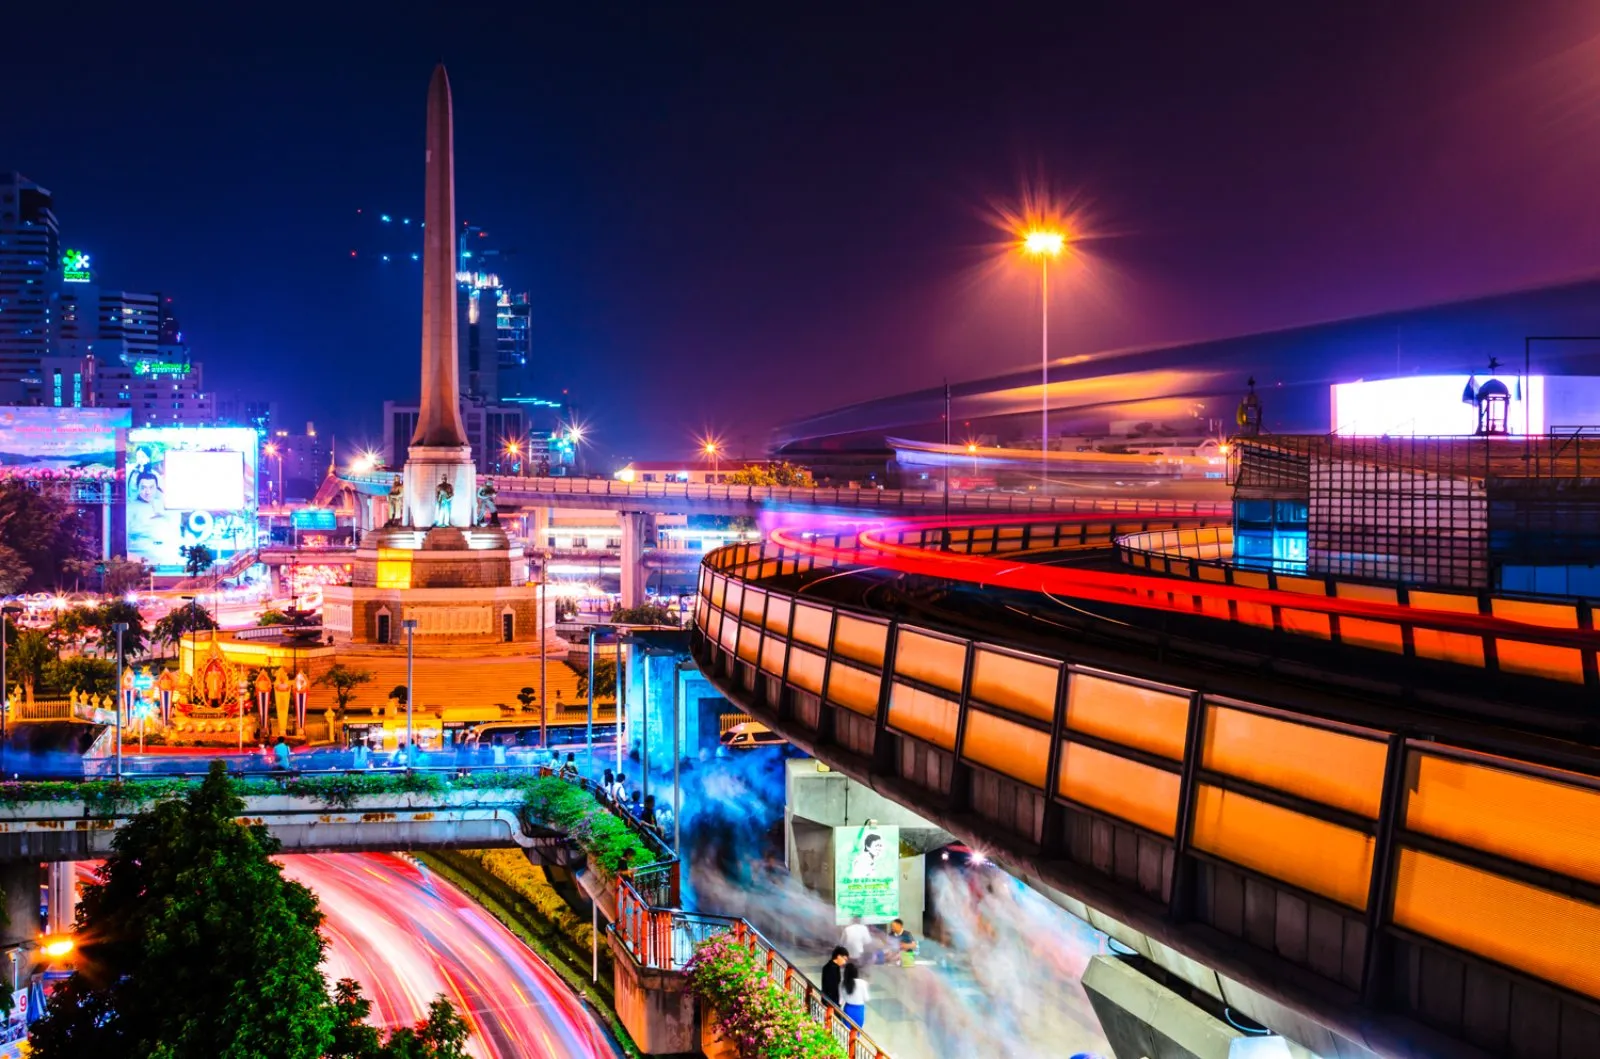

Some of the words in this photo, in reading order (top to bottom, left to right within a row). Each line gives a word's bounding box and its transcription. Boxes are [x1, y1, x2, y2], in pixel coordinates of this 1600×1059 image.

[183, 364, 191, 373] 2
[188, 510, 214, 542] 9
[20, 995, 27, 1012] 9
